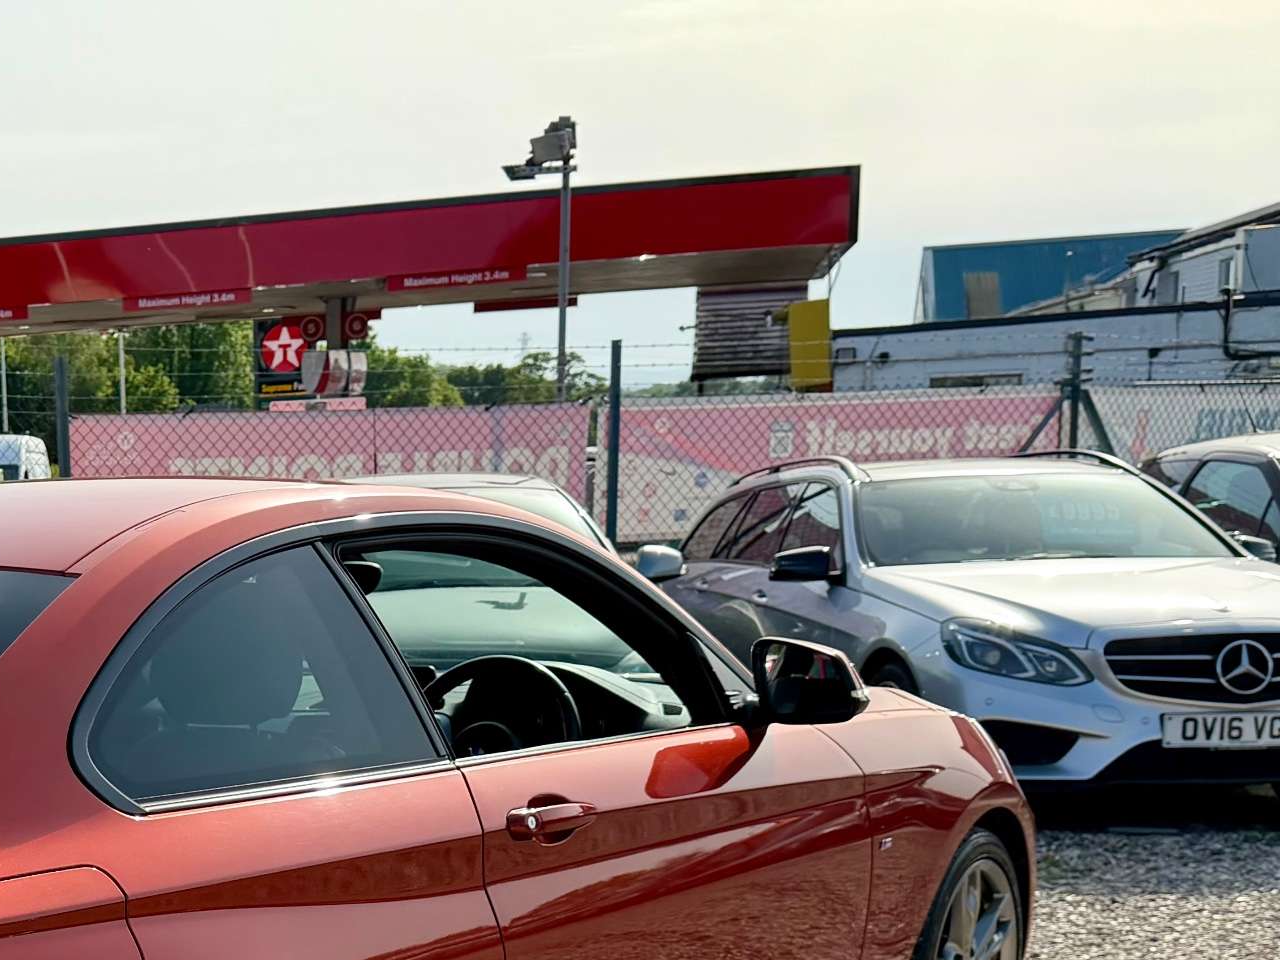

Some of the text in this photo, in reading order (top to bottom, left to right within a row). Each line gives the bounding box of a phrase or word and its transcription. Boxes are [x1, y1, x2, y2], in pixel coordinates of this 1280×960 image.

[403, 270, 510, 288] Maximum Height 3.4m
[138, 292, 236, 308] Maximum Height 3.4m
[1181, 716, 1243, 741] OV16
